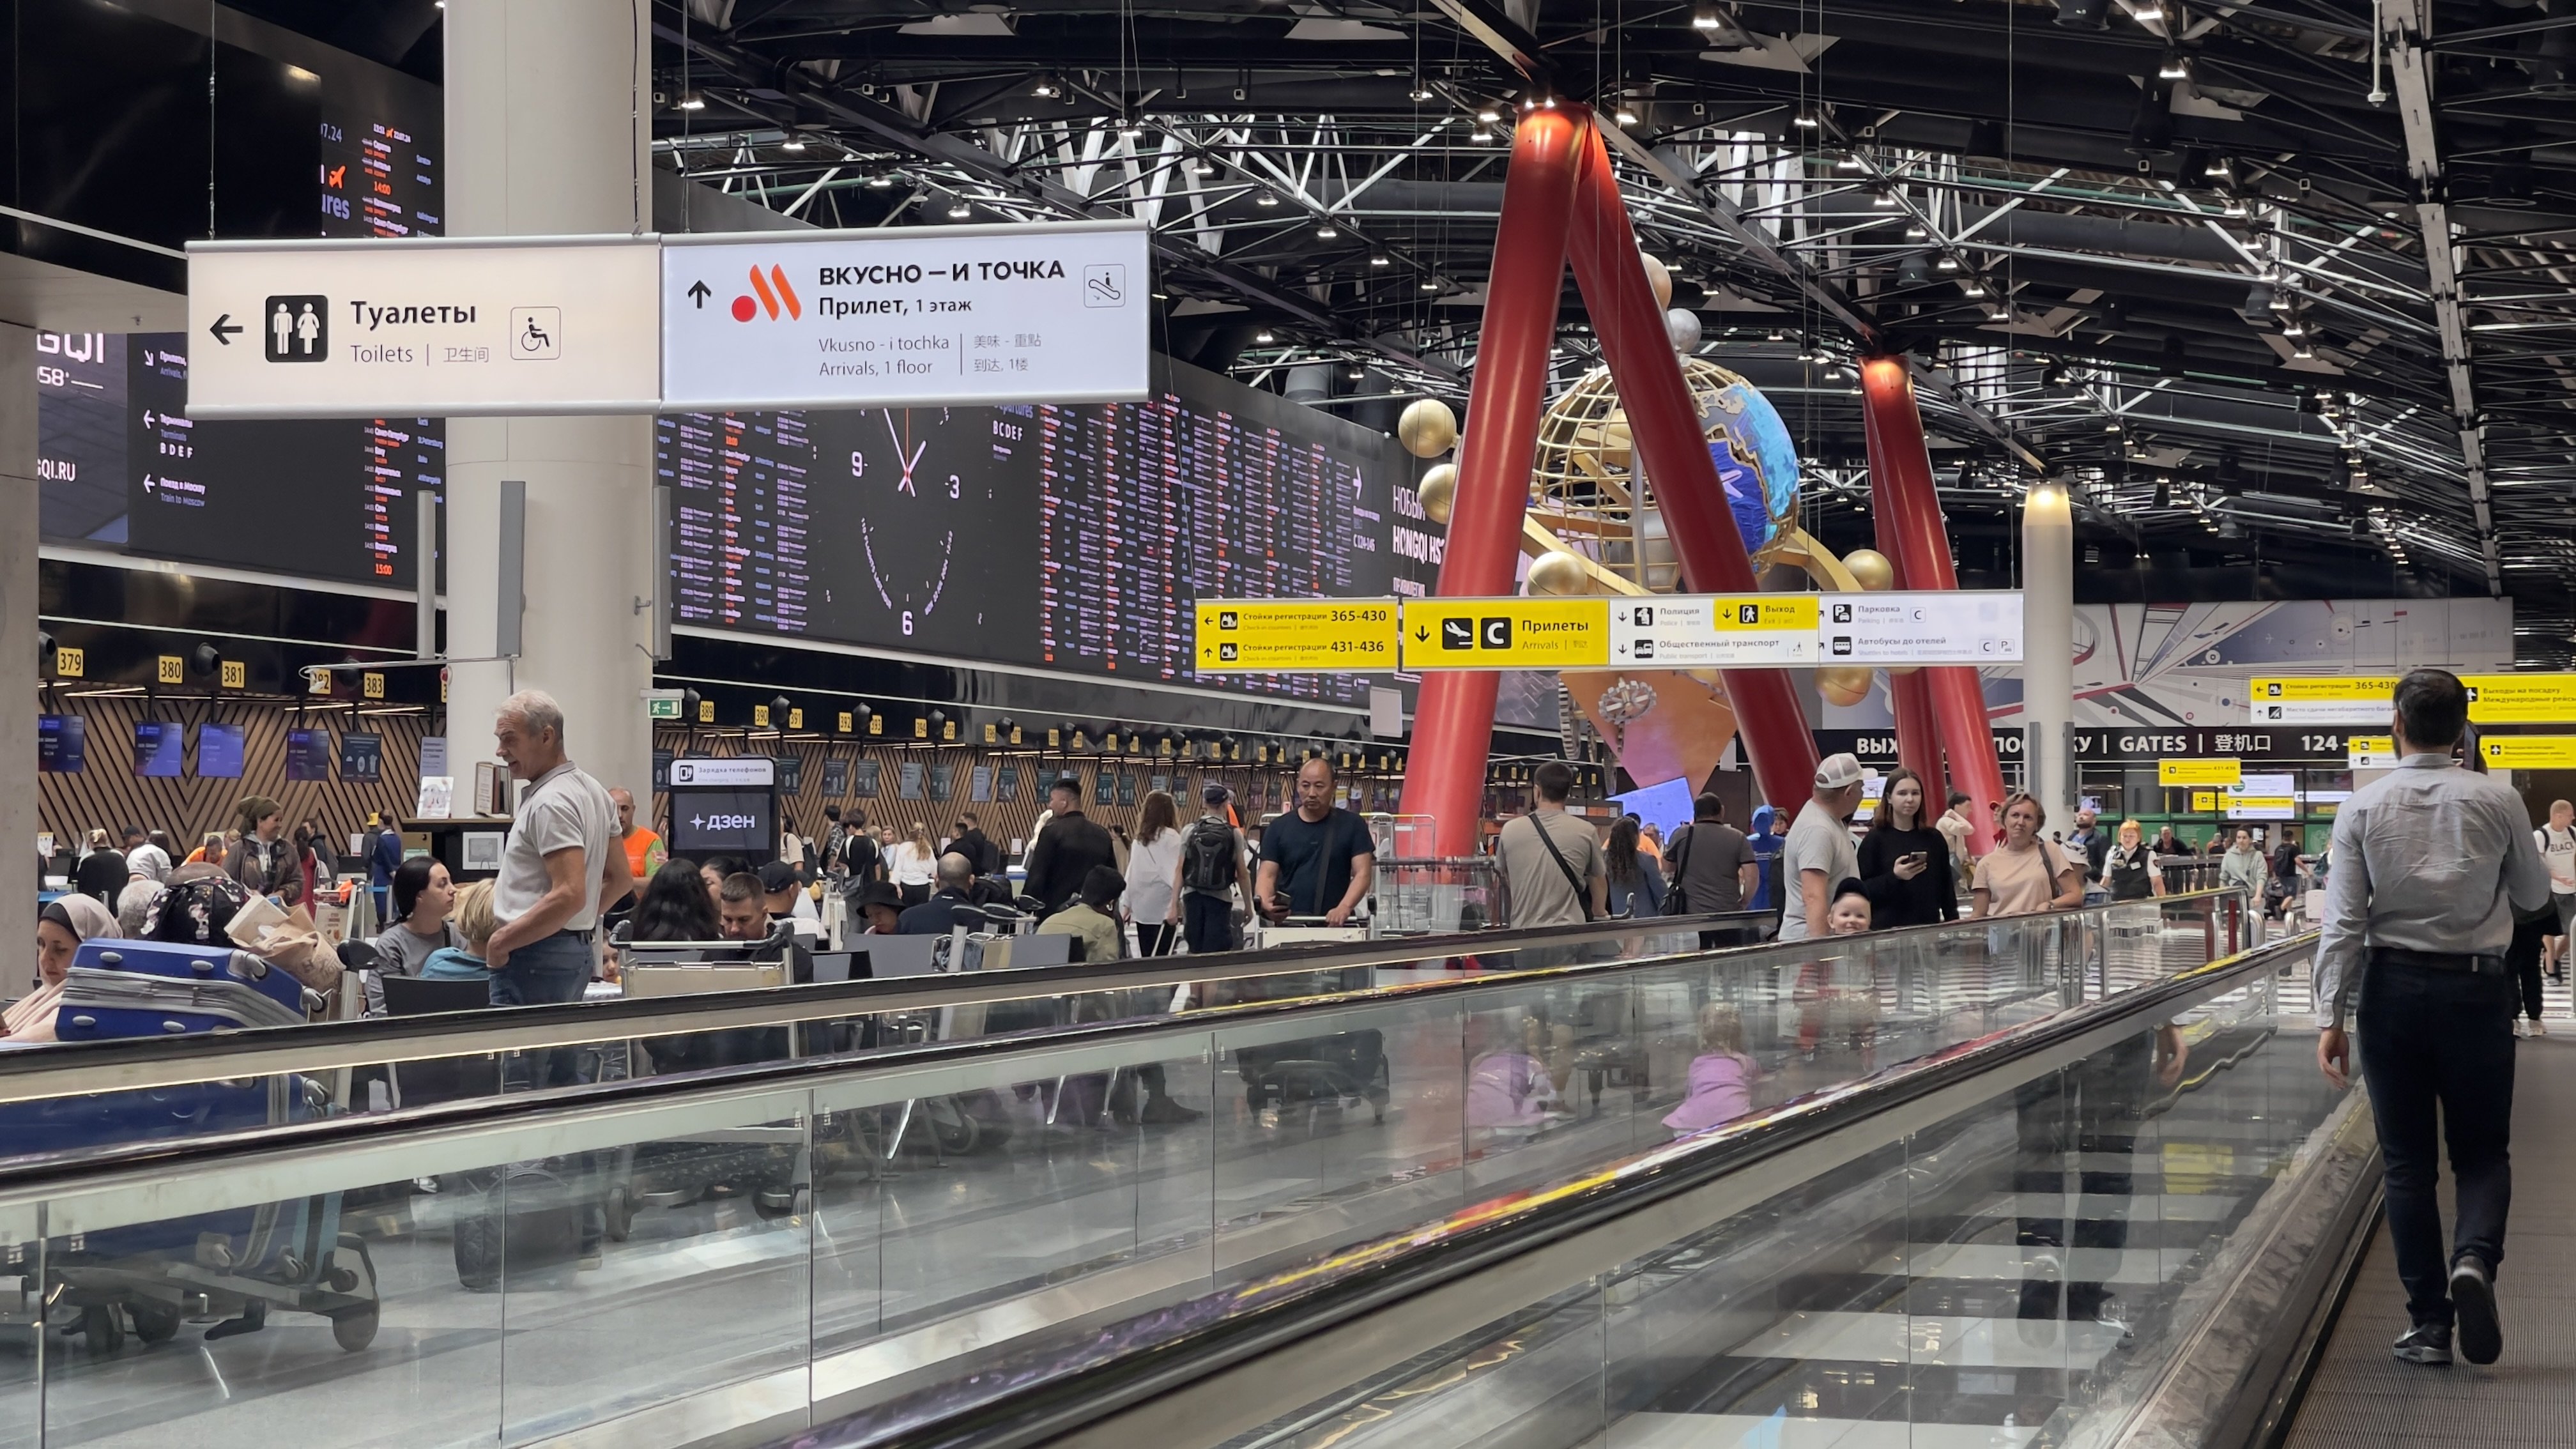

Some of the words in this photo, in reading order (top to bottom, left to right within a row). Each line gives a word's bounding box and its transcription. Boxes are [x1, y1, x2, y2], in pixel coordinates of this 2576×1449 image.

[321, 123, 342, 142] 7.24
[819, 264, 922, 286] ВКУСНО
[977, 260, 1065, 280] ТОЧКА
[351, 301, 476, 329] Туалеты
[819, 297, 908, 319] Прилет,
[930, 298, 972, 313] этаж
[819, 337, 875, 353] Vkusno
[898, 335, 949, 351] tochka
[350, 345, 413, 364] Toilets
[443, 346, 490, 364] 卫生间
[819, 361, 879, 378] Arrivals,
[897, 360, 933, 374] floor
[852, 451, 862, 477] 9
[949, 475, 960, 499] 3
[1392, 525, 1428, 564] HONGQI
[1243, 612, 1273, 620] Стойки
[1275, 613, 1328, 622] регистрации
[1331, 610, 1387, 622] 365-430
[1660, 608, 1701, 616] Полиция
[1765, 605, 1796, 614] Выход
[902, 611, 913, 635] 6
[1522, 620, 1588, 634] Прилеты
[1487, 622, 1505, 645] C
[1243, 643, 1273, 652] Стойки
[1275, 644, 1327, 653] регистрации
[1330, 641, 1384, 652] 431-436
[1522, 641, 1558, 650] Arrivals
[1659, 640, 1730, 648] Общественный
[1732, 639, 1779, 648] транспорт
[60, 652, 81, 671] 379
[161, 661, 181, 678] 380
[224, 666, 242, 683] 381
[366, 677, 382, 693] 383
[701, 705, 713, 718] 389
[756, 709, 768, 723] 390
[790, 712, 801, 724] 391
[840, 716, 851, 728] 392
[2120, 735, 2187, 752] GATES
[2214, 735, 2271, 752] 登机口
[2301, 735, 2338, 751] 124
[707, 815, 755, 830] дзен
